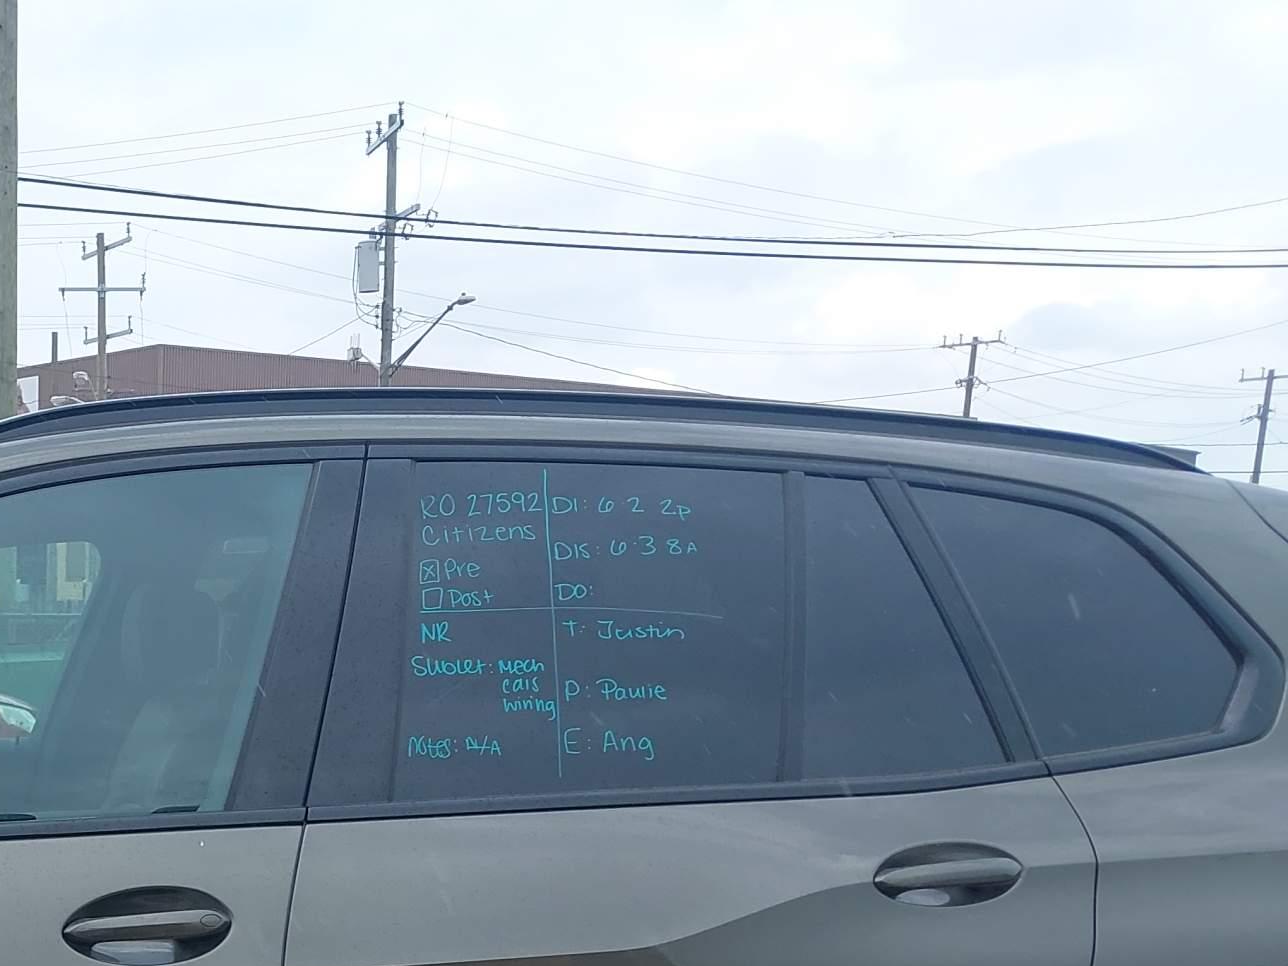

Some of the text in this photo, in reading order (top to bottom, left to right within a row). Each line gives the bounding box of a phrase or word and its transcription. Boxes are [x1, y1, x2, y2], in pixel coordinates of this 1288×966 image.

[420, 491, 543, 519] RO 27592
[422, 525, 536, 546] Citizens
[444, 558, 481, 580] Pre
[447, 589, 496, 608] Post
[420, 621, 452, 644] NR
[596, 620, 685, 640] Justin
[596, 678, 667, 701] Paulie
[465, 735, 502, 756] N/A
[602, 730, 655, 761] Ang
